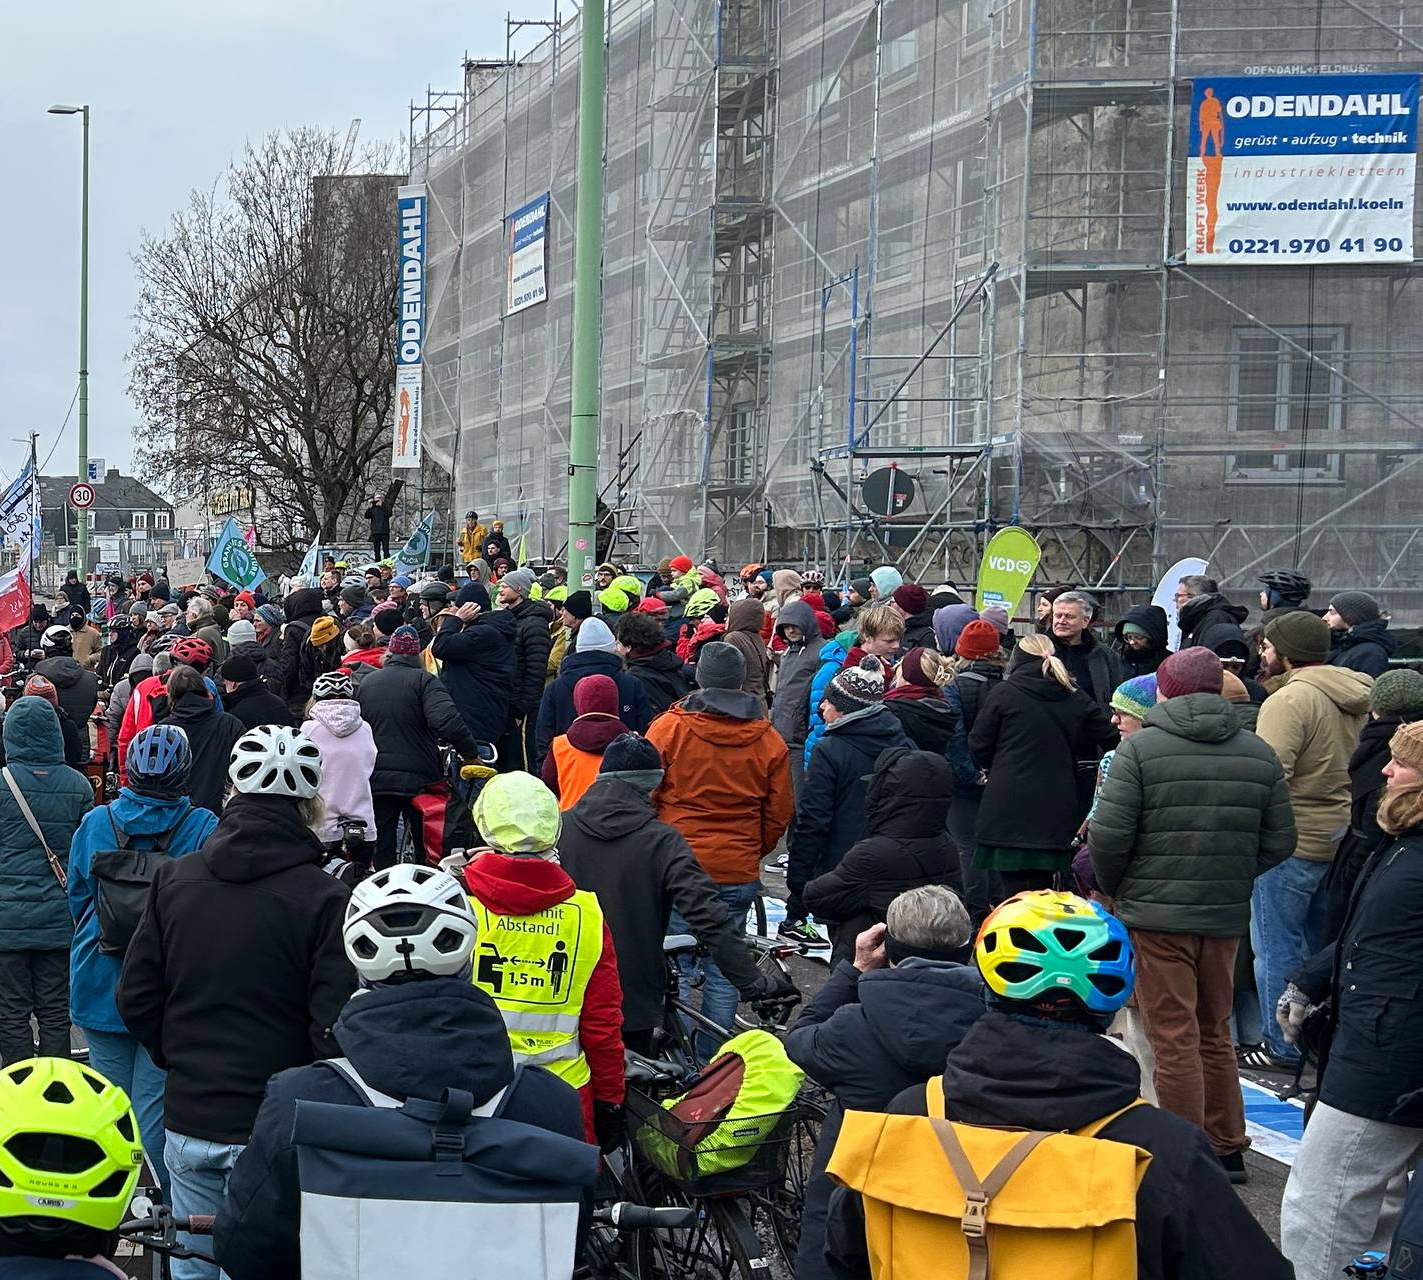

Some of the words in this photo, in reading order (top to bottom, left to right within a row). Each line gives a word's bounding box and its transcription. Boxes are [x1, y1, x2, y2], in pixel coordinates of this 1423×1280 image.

[1226, 93, 1410, 118] ODENDAHL
[1234, 134, 1278, 149] gerüst
[1291, 132, 1337, 147] aufzug
[1352, 131, 1408, 144] technik
[1233, 165, 1405, 178] industrieklettern
[1195, 168, 1206, 204] WERK
[1226, 197, 1404, 212] www.odendahl.koeln
[514, 205, 546, 233] ODENDAHL
[1195, 213, 1206, 254] KRAFT
[1228, 238, 1330, 254] 0221.970
[1339, 238, 1365, 252] 41
[1373, 237, 1403, 252] 90
[400, 199, 421, 363] ODENDAHL
[75, 490, 90, 501] 30
[223, 540, 243, 568] GRANIES
[989, 555, 1015, 571] VCD
[540, 907, 565, 920] mit
[496, 916, 560, 936] Abstand!
[509, 972, 528, 986] 1,5
[530, 976, 545, 987] m
